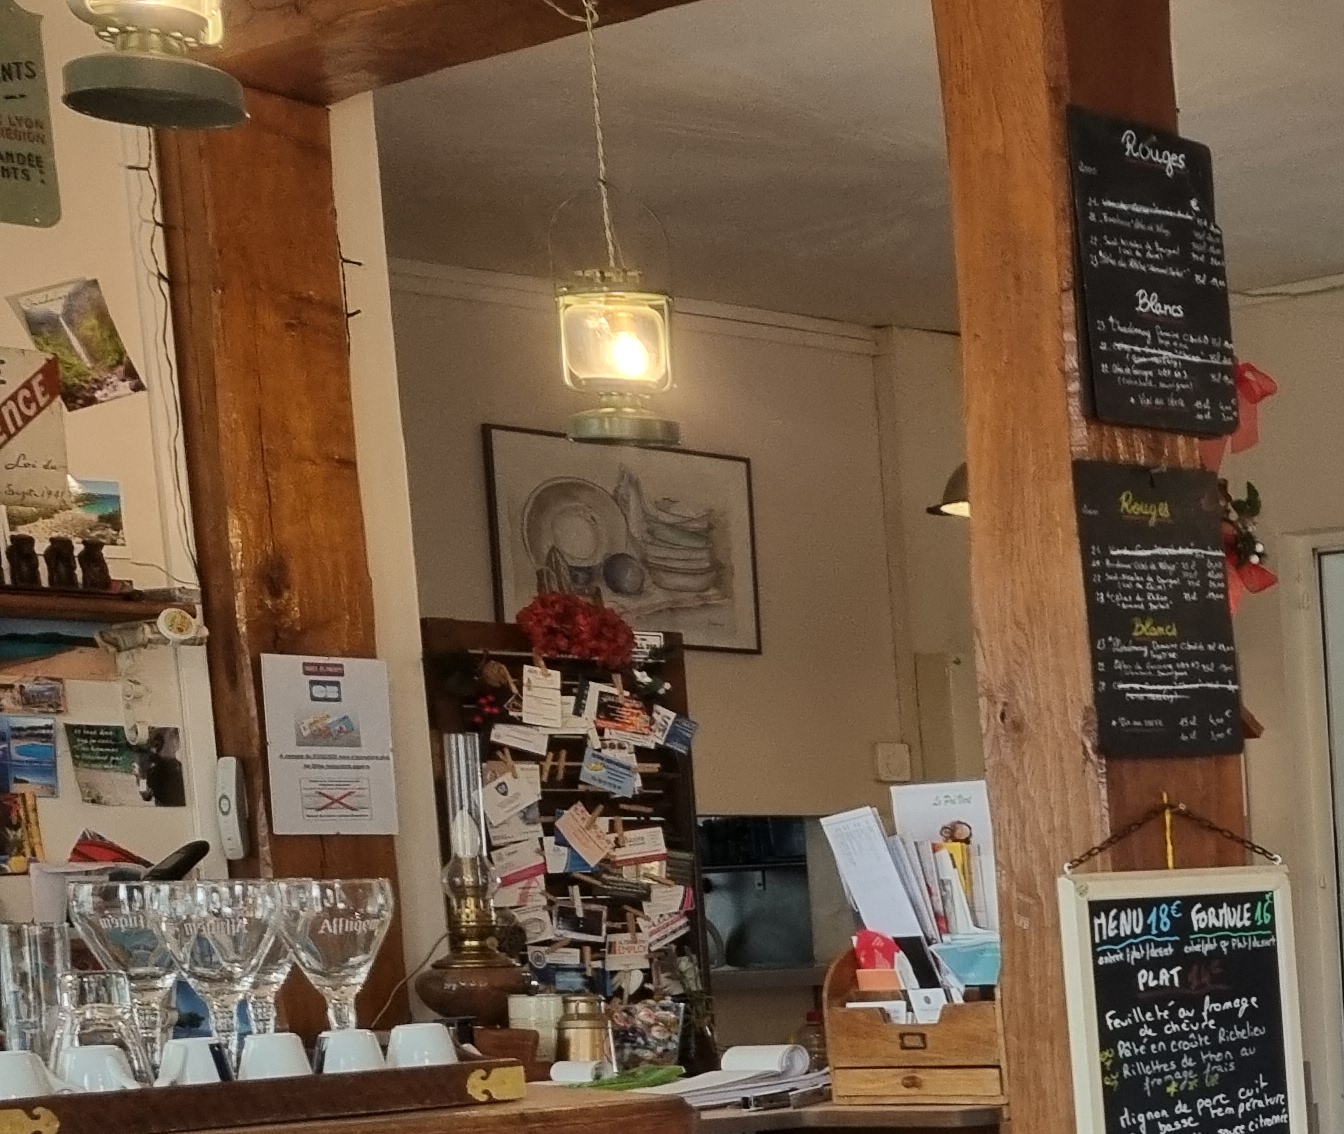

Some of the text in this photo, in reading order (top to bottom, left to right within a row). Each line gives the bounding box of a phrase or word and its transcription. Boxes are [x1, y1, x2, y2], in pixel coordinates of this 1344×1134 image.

[1121, 129, 1186, 179] Rouges
[1135, 288, 1185, 318] Blancs
[1093, 907, 1144, 944] MENU
[1190, 901, 1252, 932] FORMULE
[1137, 965, 1183, 992] PLAT
[1105, 995, 1259, 1031] Feuilleté au fromage
[1138, 1018, 1217, 1038] de chèvre
[1150, 1040, 1167, 1054] en
[1170, 1032, 1212, 1053] croûte
[1218, 1020, 1267, 1045] Richelieu
[1122, 1058, 1177, 1080] Rillettes
[1180, 1053, 1197, 1068] de
[1240, 1046, 1257, 1057] au
[1143, 1071, 1199, 1098] fromage
[1174, 1100, 1193, 1116] de
[1196, 1093, 1231, 1117] porc
[1237, 1073, 1269, 1100] cuit
